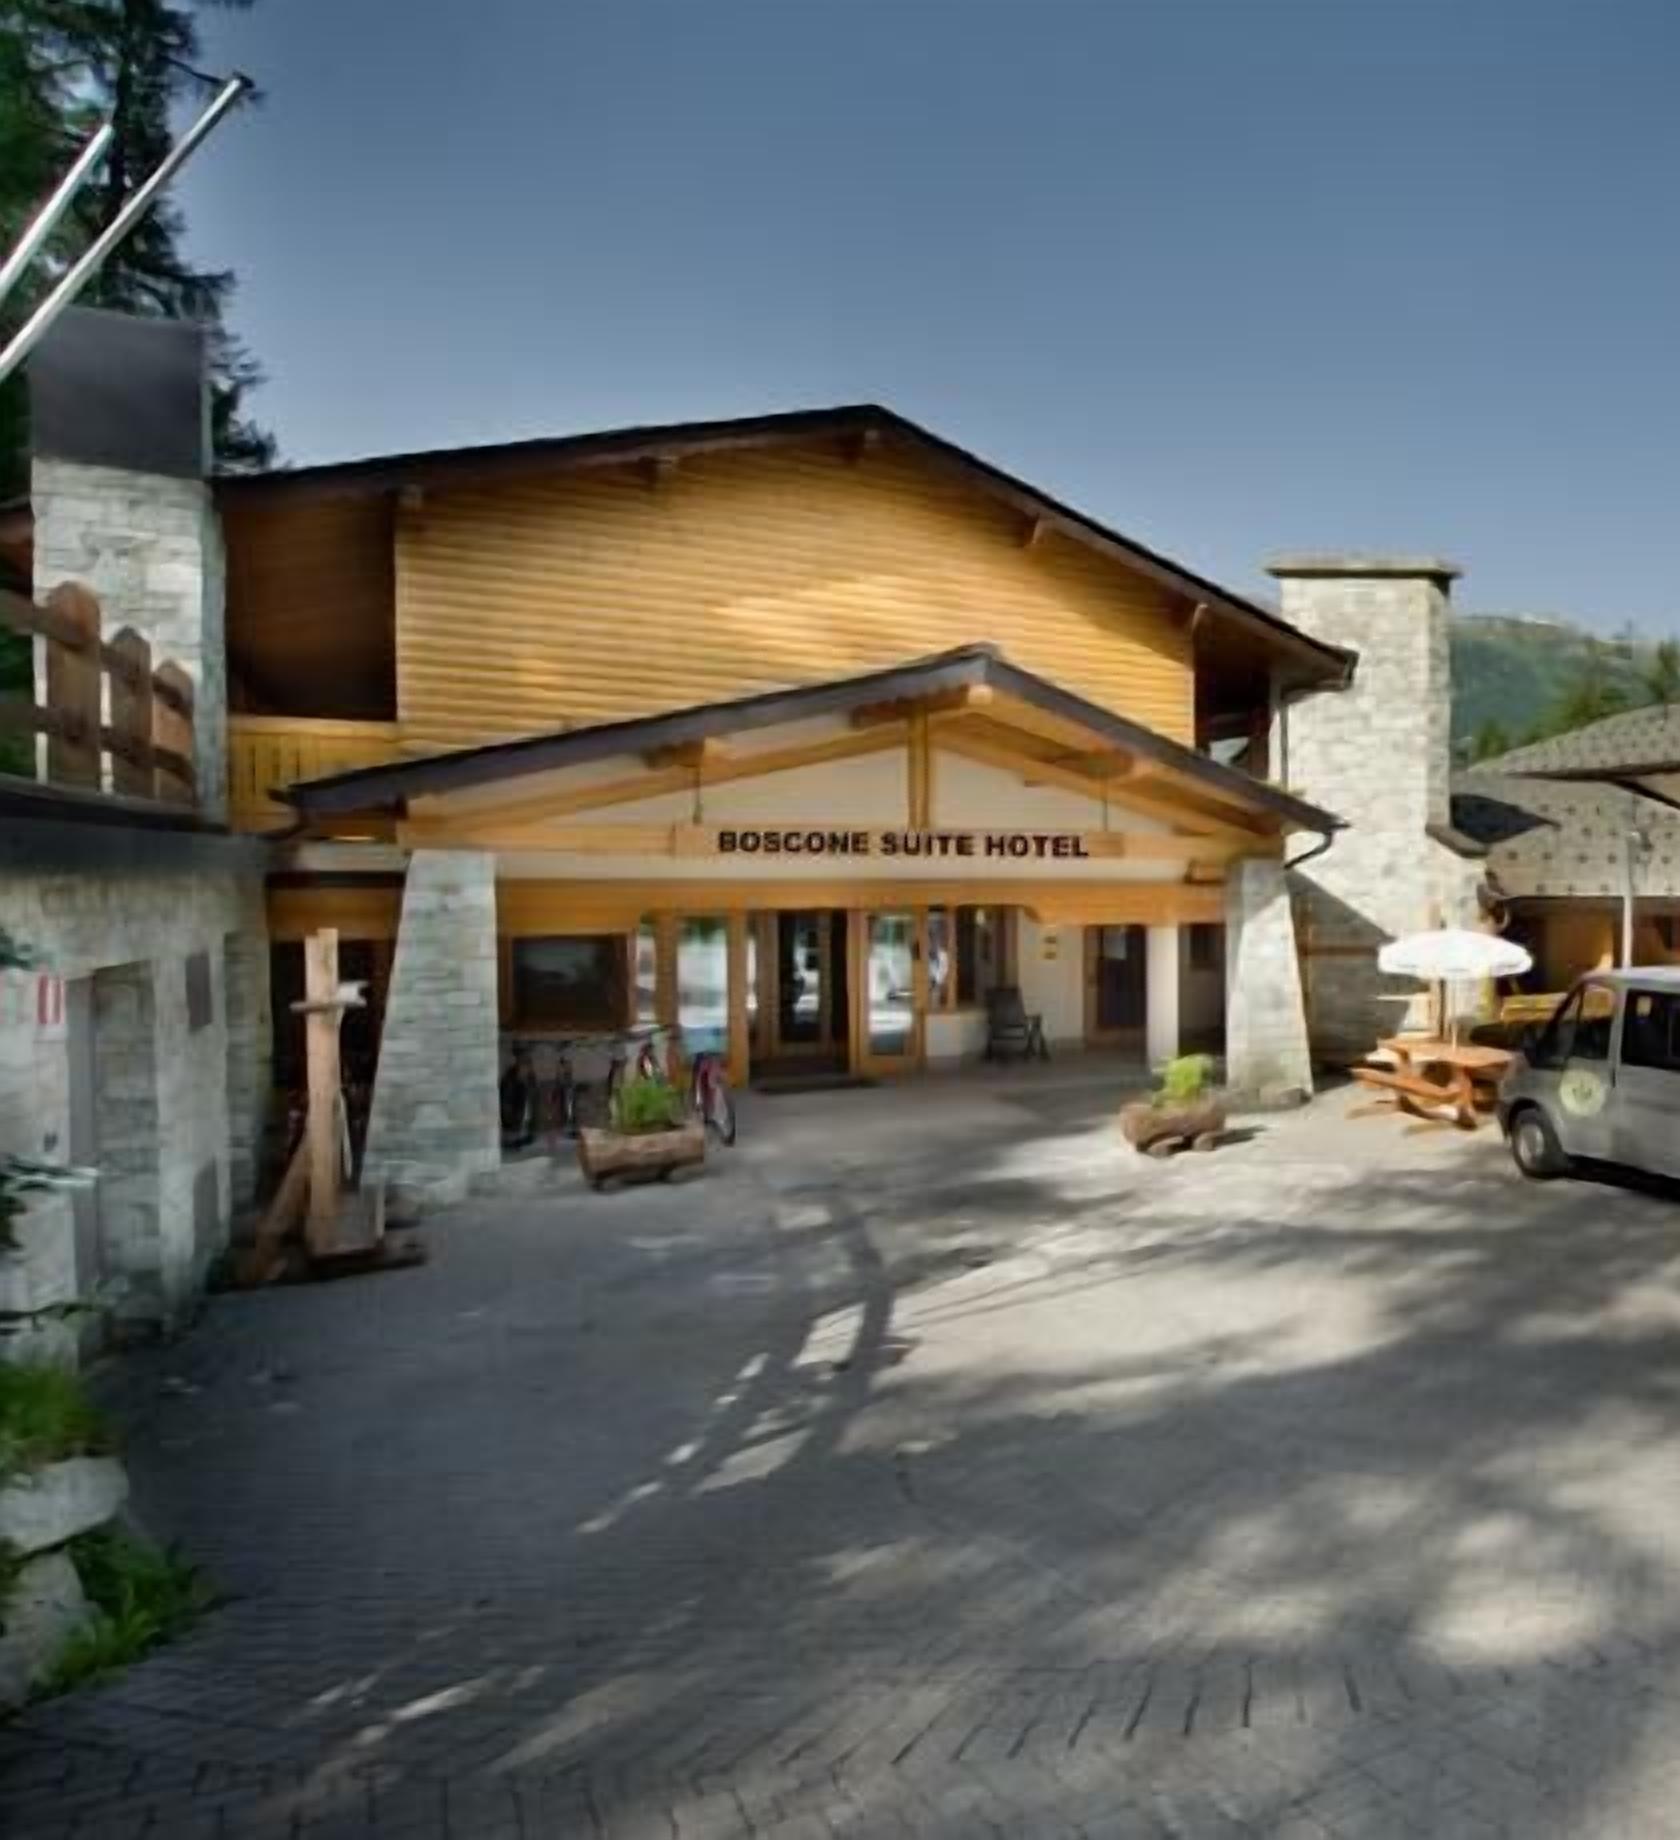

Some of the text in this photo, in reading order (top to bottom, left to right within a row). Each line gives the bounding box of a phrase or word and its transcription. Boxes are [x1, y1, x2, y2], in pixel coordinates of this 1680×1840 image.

[718, 831, 1089, 858] BOSCONE SUITE HOTEL
